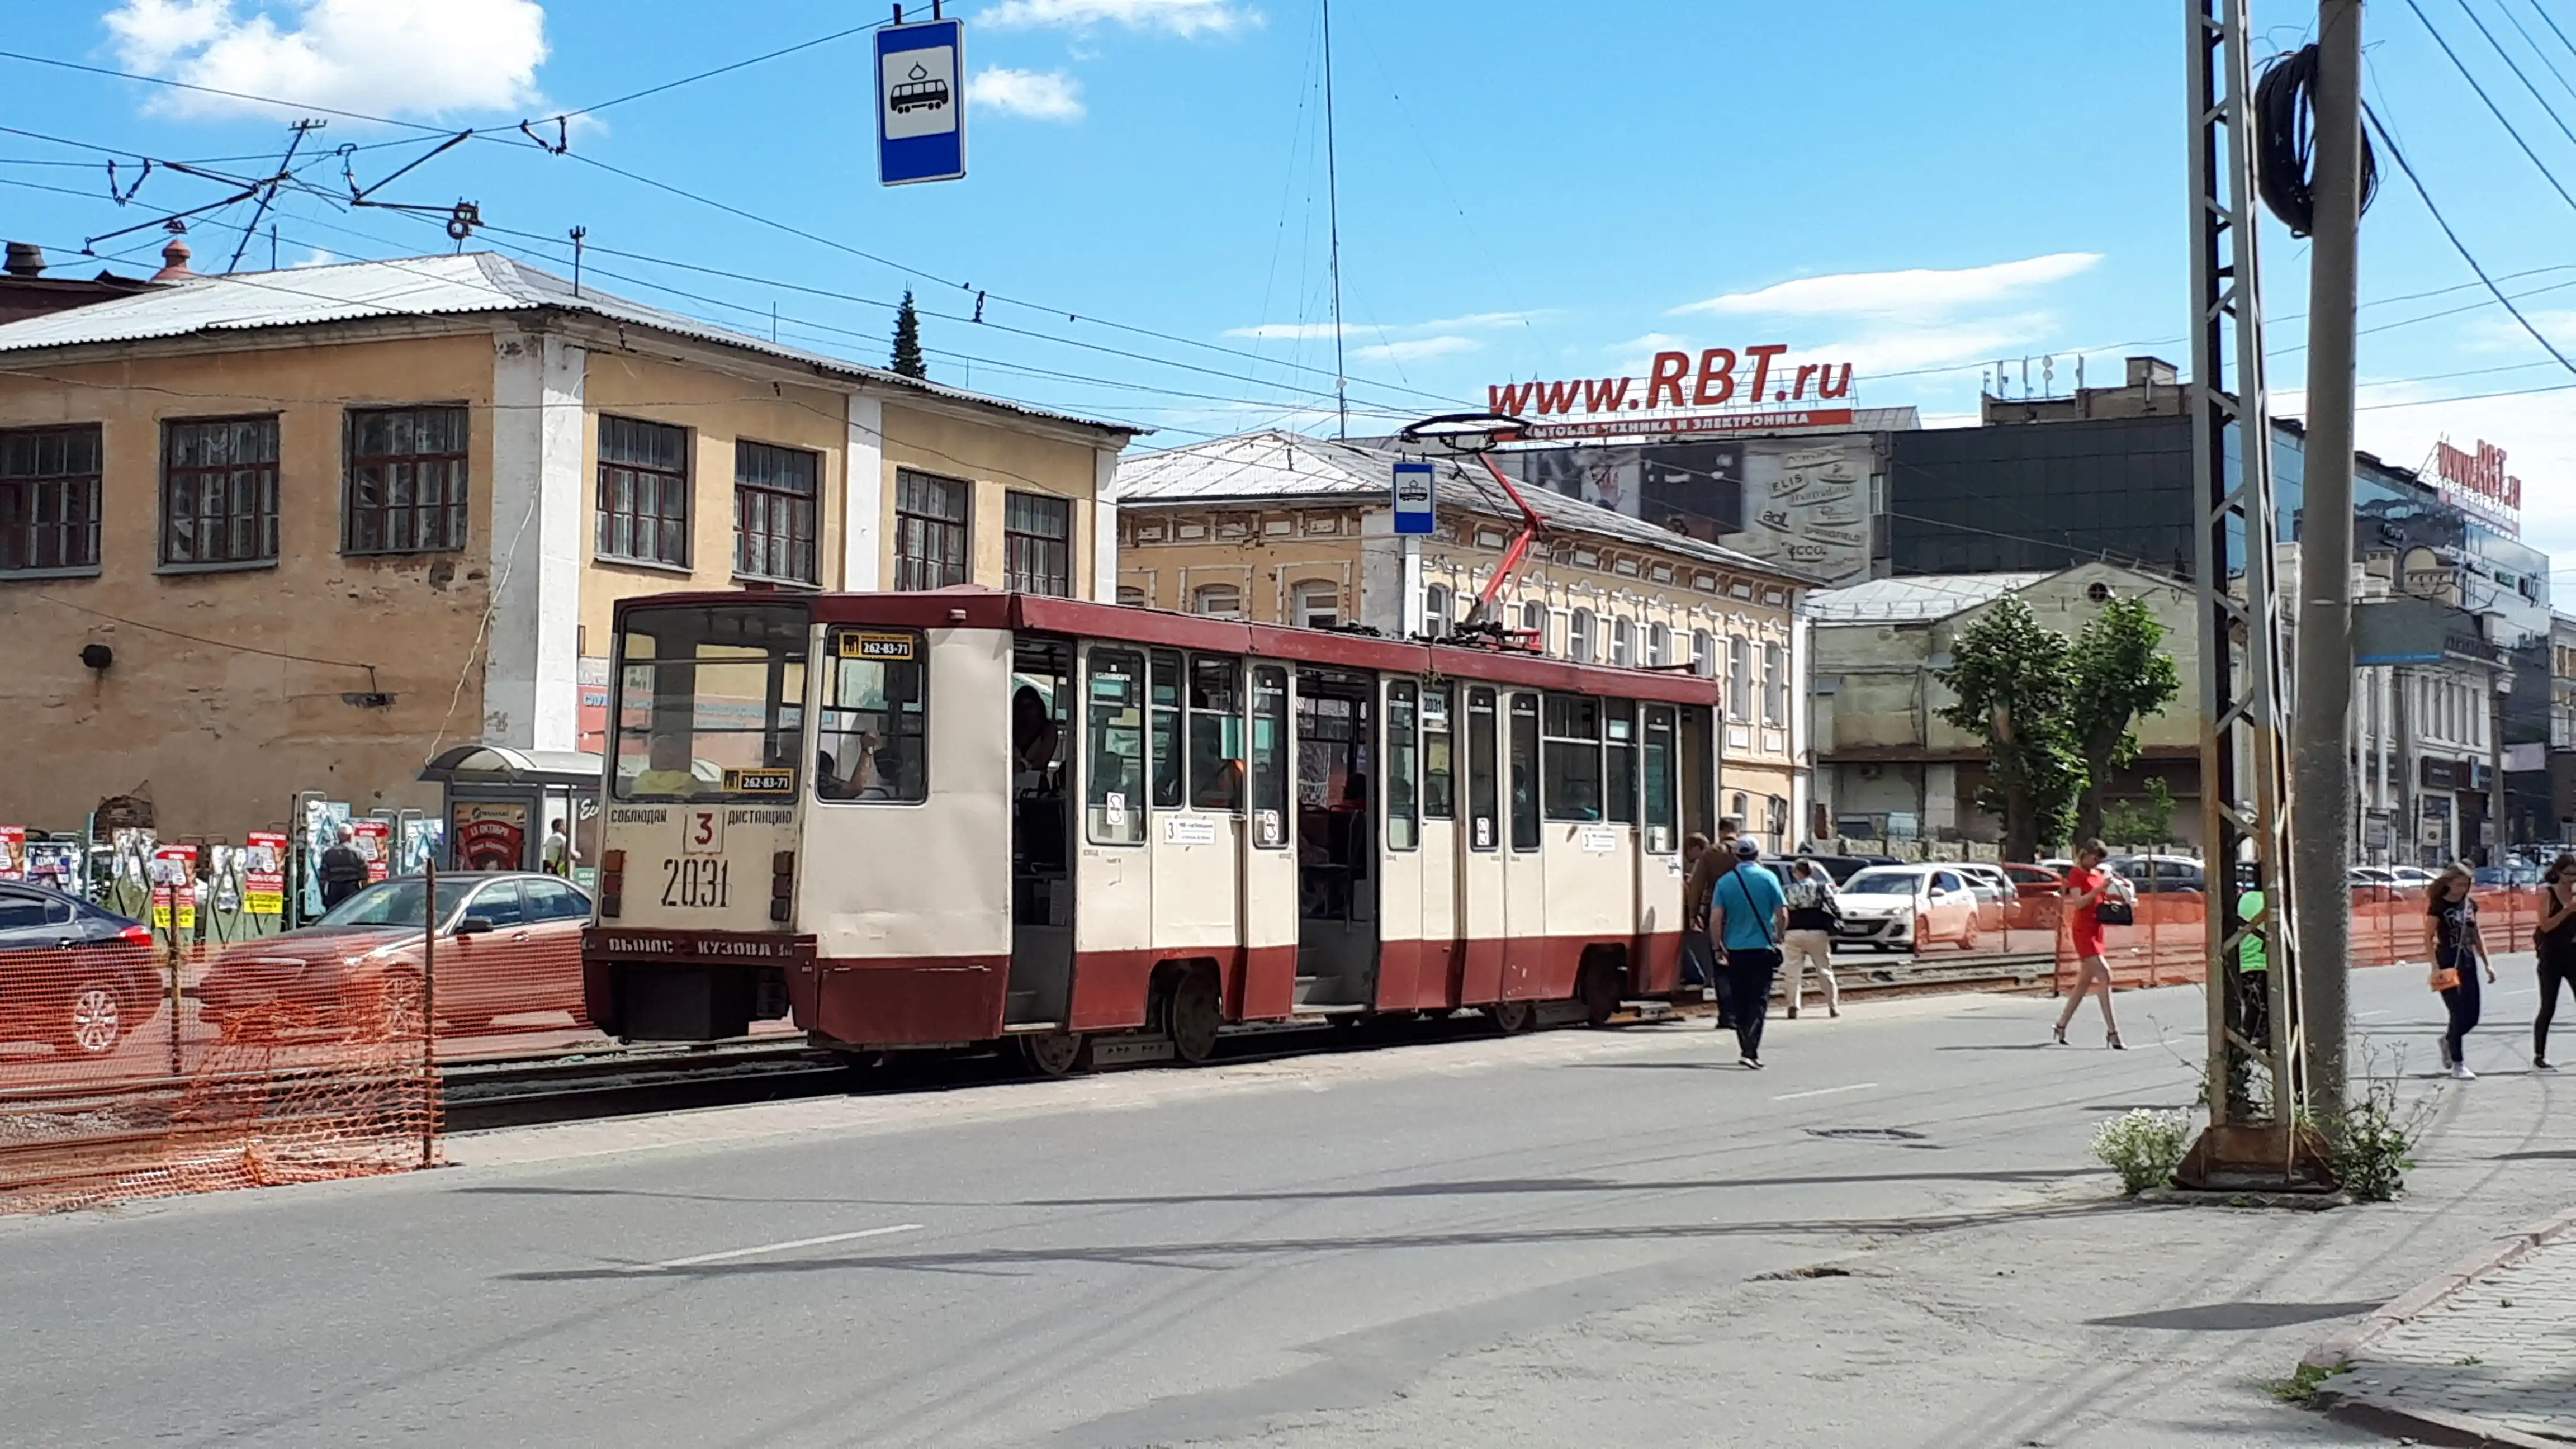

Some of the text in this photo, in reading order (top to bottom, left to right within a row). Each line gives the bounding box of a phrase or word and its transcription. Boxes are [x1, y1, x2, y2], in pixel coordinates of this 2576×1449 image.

[1488, 344, 1852, 416] www.RBT.ru
[1693, 414, 1809, 429] ЭЛЕКТРОНИКА
[1772, 474, 1803, 492] ELIS
[863, 642, 907, 654] 262-83-71
[744, 777, 788, 788] 262-83-71
[728, 810, 792, 826] ДИСТАНЦИЮ
[695, 813, 713, 845] 3
[1168, 822, 1174, 839] 3
[661, 859, 728, 907] 2031
[609, 938, 674, 953] ВЫНОС
[698, 940, 771, 956] КУЗОВА
